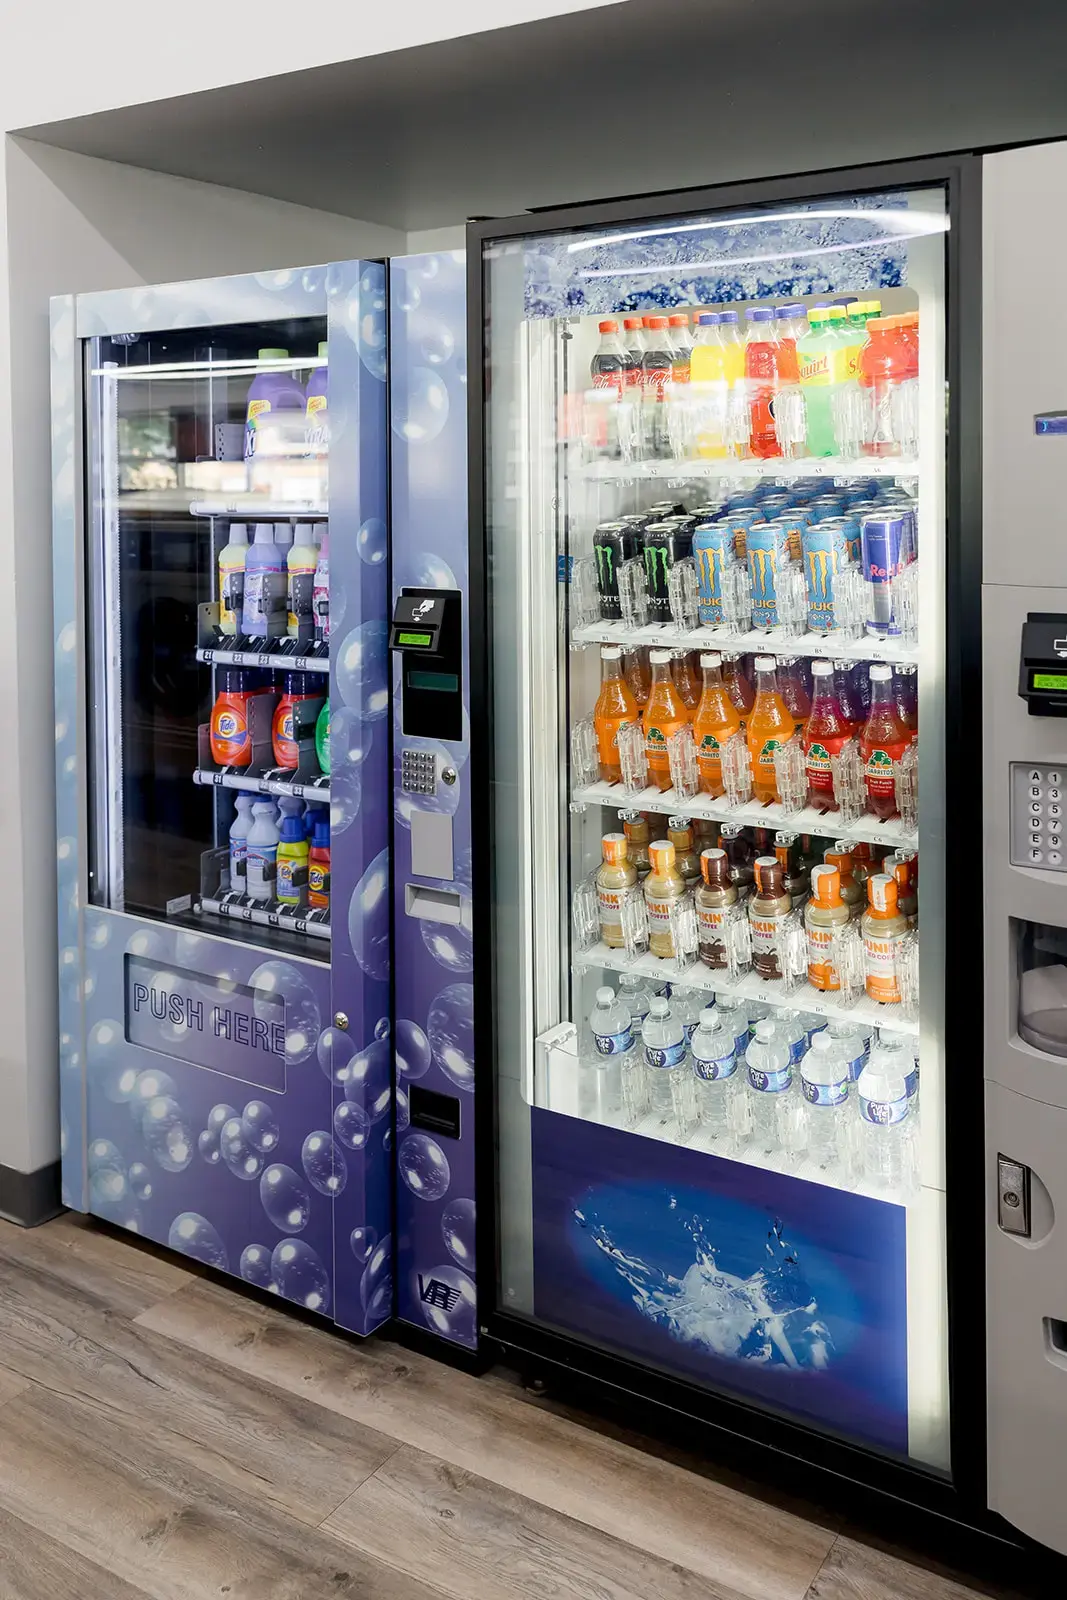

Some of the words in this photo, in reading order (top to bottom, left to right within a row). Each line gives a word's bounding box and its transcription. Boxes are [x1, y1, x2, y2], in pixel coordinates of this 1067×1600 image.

[800, 356, 827, 378] quirt
[870, 563, 894, 576] Red
[700, 597, 723, 606] JUIC
[809, 602, 834, 611] JUIC
[297, 660, 306, 668] 24
[220, 719, 234, 731] Tide
[1032, 772, 1039, 780] A
[1053, 774, 1057, 782] 1
[1052, 790, 1058, 798] 3
[1032, 803, 1039, 811] C
[1052, 805, 1058, 813] 5
[1032, 819, 1039, 827] D
[1052, 821, 1058, 829] 7
[1032, 834, 1039, 842] E
[1052, 836, 1058, 845] 9
[310, 872, 324, 882] Tide
[297, 922, 305, 930] 44
[134, 983, 204, 1031] PUSH
[214, 1006, 285, 1056] HERE
